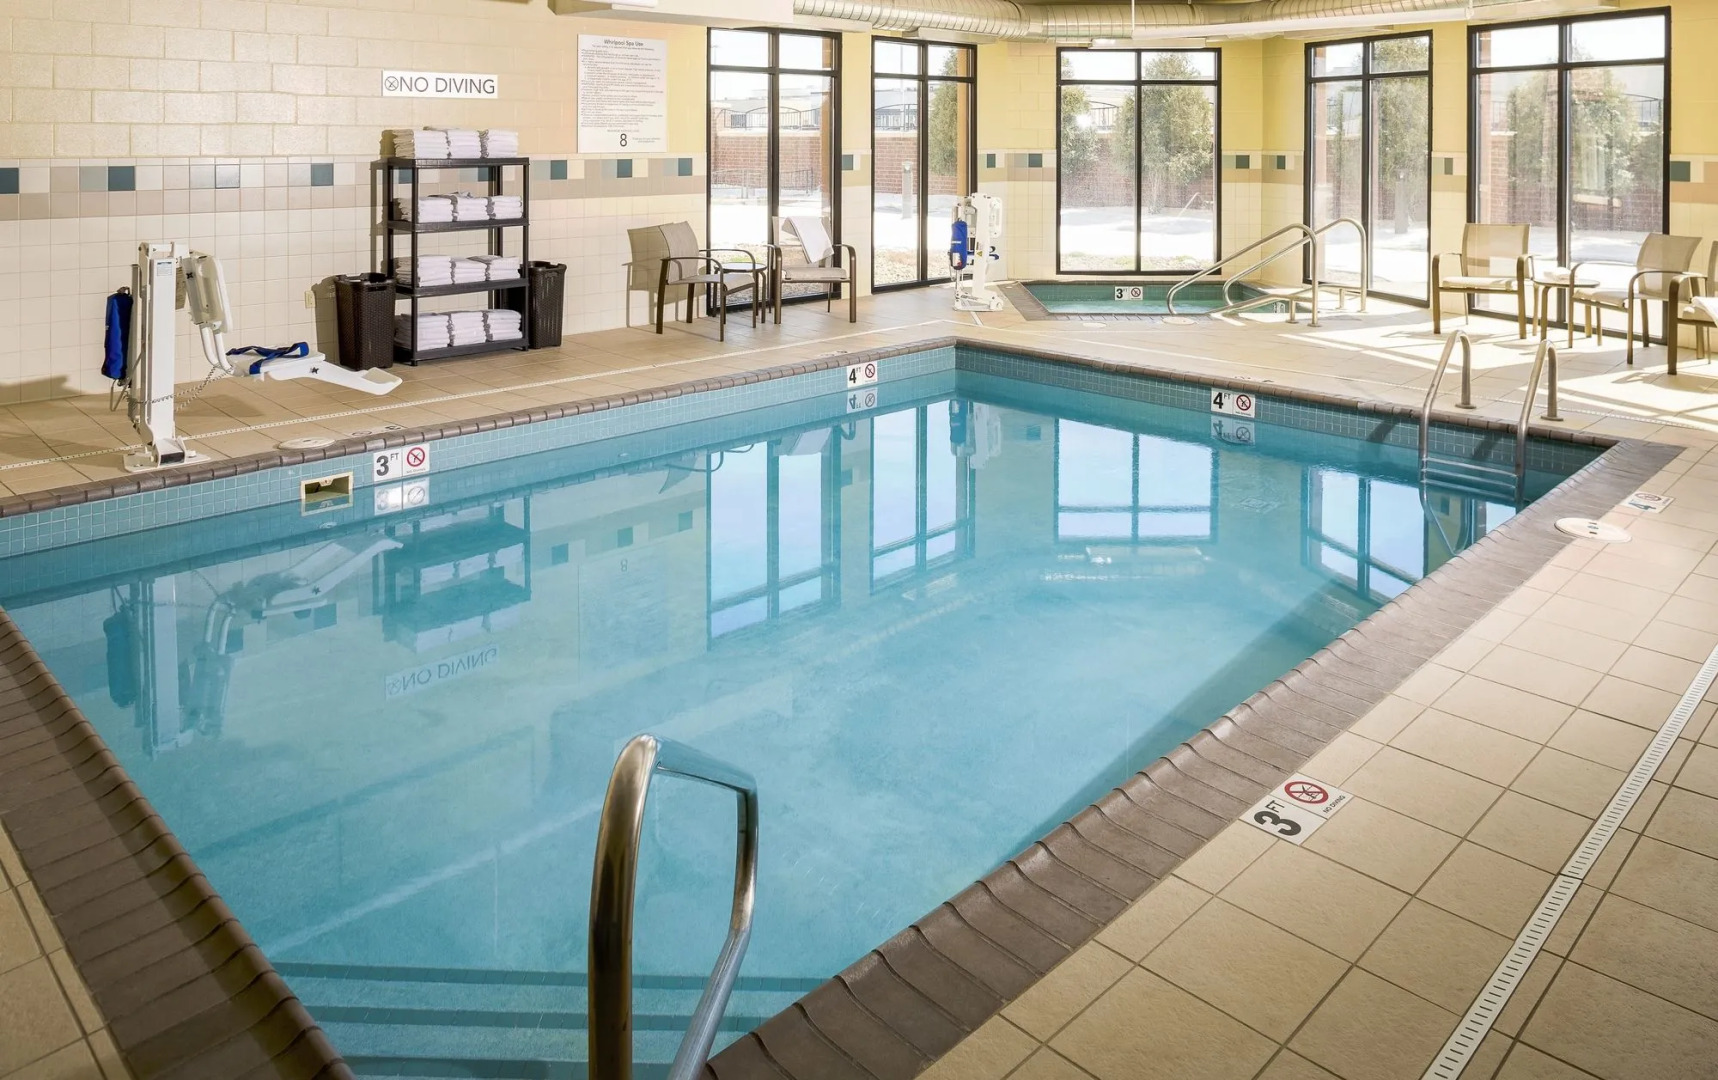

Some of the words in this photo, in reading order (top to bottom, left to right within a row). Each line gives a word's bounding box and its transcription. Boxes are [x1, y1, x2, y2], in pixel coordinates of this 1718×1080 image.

[604, 39, 626, 47] Whirlpool
[400, 76, 429, 92] NO
[435, 77, 495, 94] DIVING
[620, 133, 627, 147] 8
[1116, 288, 1123, 299] 3
[849, 368, 857, 384] 4
[1213, 392, 1224, 409] 4
[376, 455, 389, 476] 3
[390, 452, 400, 461] FT
[1629, 501, 1657, 511] 4
[1265, 799, 1285, 813] FT
[1253, 810, 1302, 836] 3
